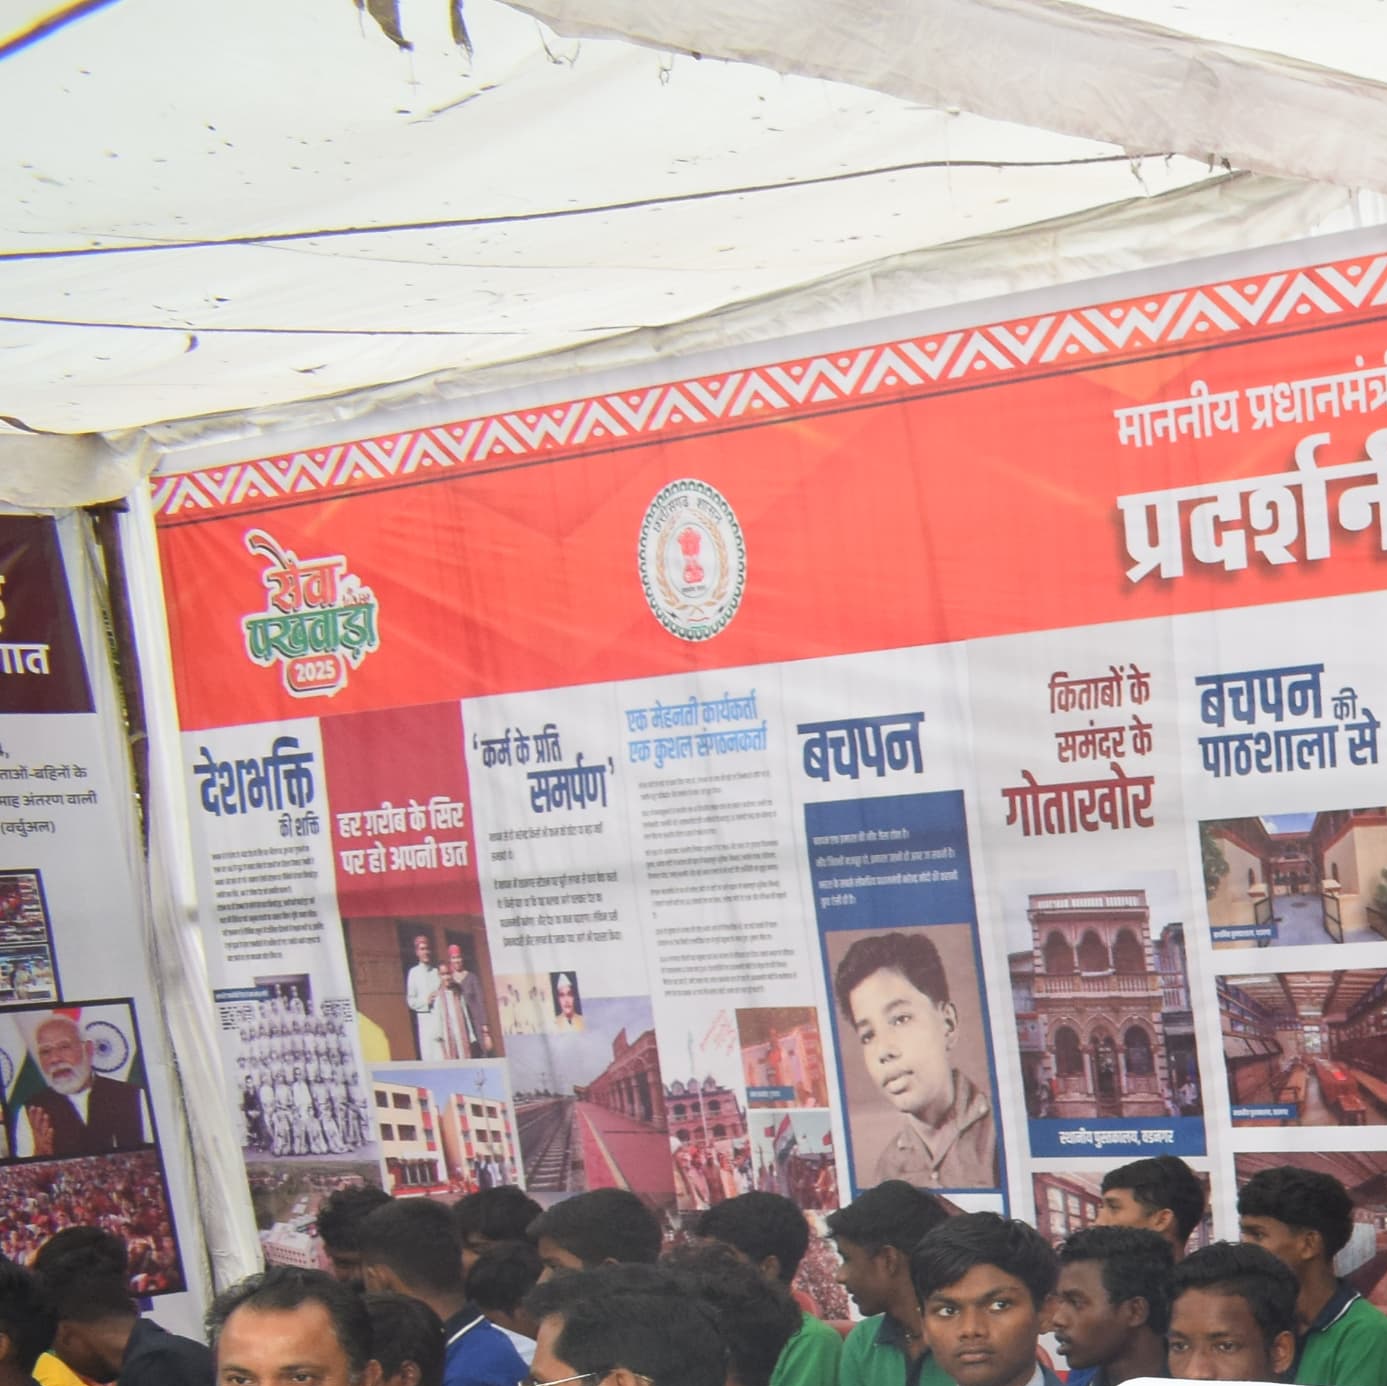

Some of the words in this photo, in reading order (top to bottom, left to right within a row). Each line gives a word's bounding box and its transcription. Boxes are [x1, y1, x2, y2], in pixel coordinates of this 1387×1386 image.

[1113, 379, 1240, 448] माननीय
[248, 534, 343, 613] सेवा
[246, 603, 376, 660] पखवाड़ा
[294, 660, 336, 682] 2025
[1048, 665, 1125, 714] किताबों
[1126, 663, 1151, 705] के
[1195, 663, 1325, 728] बचपन
[1331, 687, 1358, 721] की
[796, 711, 925, 782] बचपन
[1054, 719, 1126, 763] समंदर
[1128, 714, 1153, 756] के
[1197, 725, 1339, 778] पाठशाला
[1344, 707, 1381, 766] से
[193, 737, 314, 817] देशभक्ति
[1001, 761, 1155, 837] गोताखोर
[336, 812, 363, 838] हर
[407, 799, 428, 831] के
[427, 796, 464, 830] सिर
[339, 849, 366, 875] पर
[366, 840, 387, 873] हो
[389, 836, 439, 871] अपनी
[438, 841, 468, 867] छत
